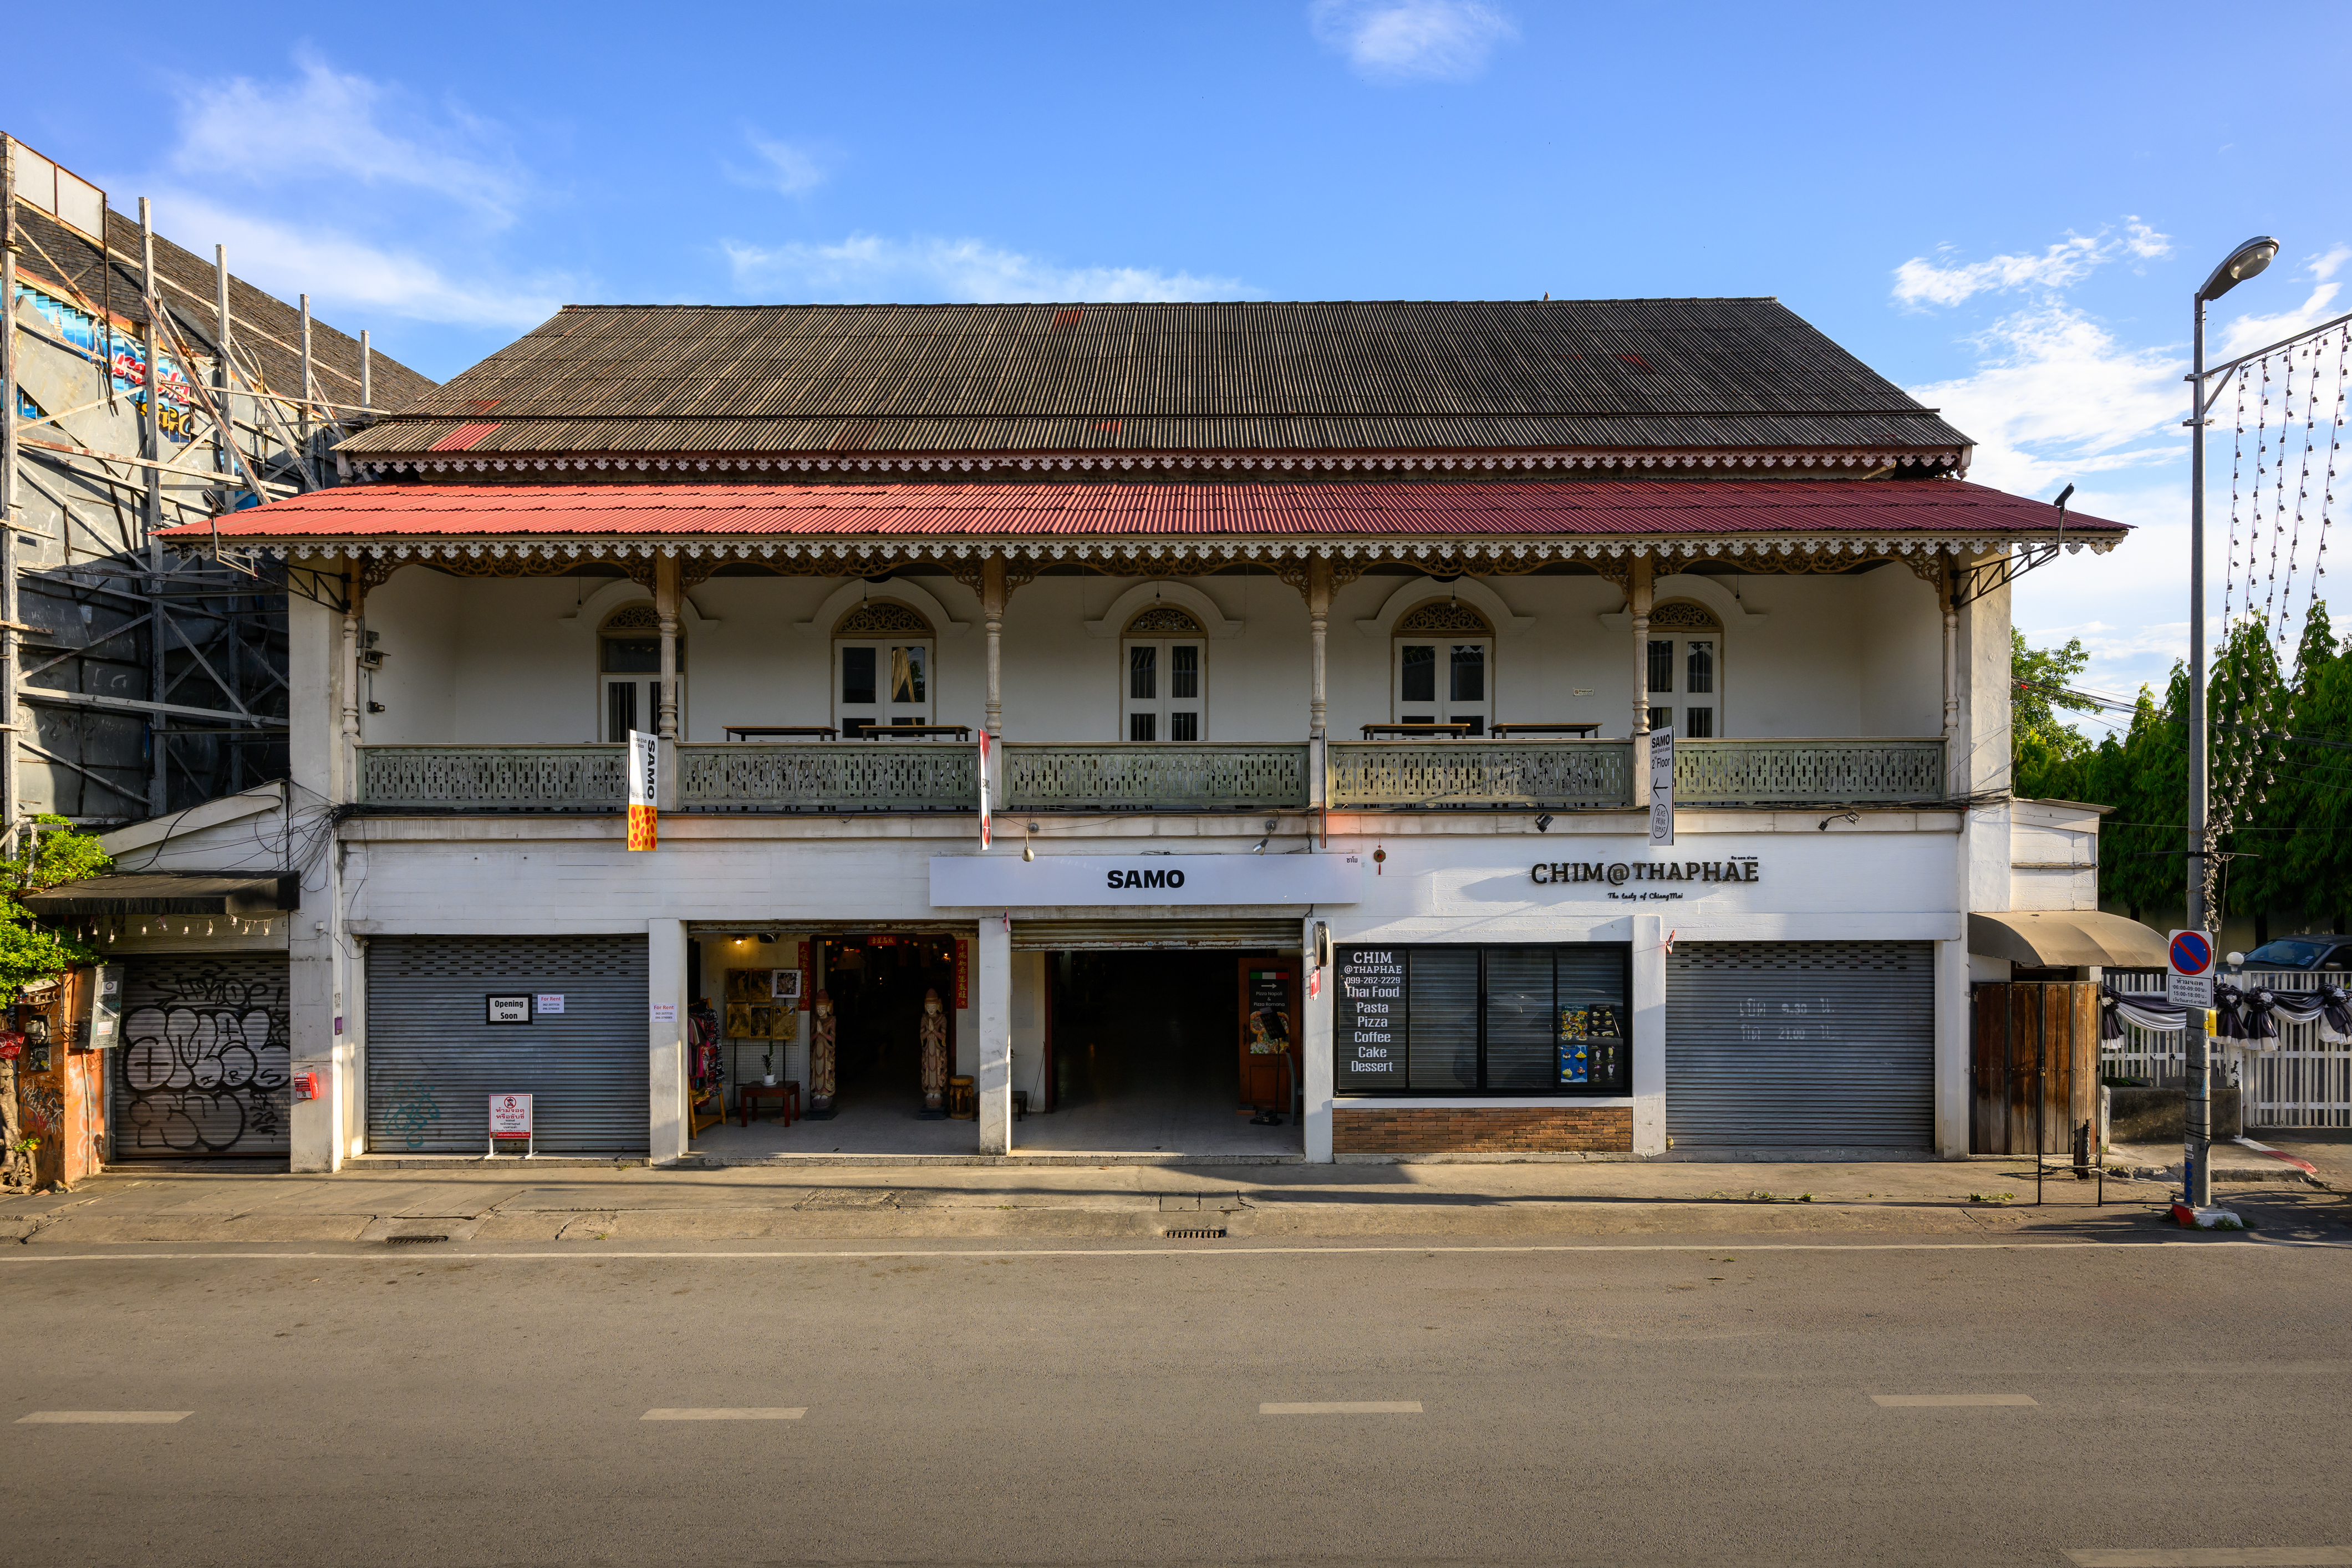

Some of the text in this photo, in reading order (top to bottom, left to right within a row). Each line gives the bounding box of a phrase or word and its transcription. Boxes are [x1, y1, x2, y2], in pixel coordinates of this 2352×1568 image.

[1651, 734, 1670, 749] SAMO
[1657, 757, 1671, 768] Floor
[647, 739, 655, 800] SAMO
[1657, 808, 1666, 817] SLICE
[1656, 817, 1666, 826] DRINK
[1654, 824, 1666, 834] REPEAT
[1107, 869, 1185, 889] SAMO
[1530, 862, 1759, 886] CHIM@THAPHAE
[1621, 892, 1637, 902] tasty
[1640, 892, 1647, 901] of
[1353, 951, 1392, 964] CHIM
[1344, 965, 1402, 974] @THAPHAE
[2176, 978, 2203, 986] ห้ามจอด
[1345, 986, 1399, 997] Thai Food
[495, 1000, 523, 1008] Opening
[1357, 1002, 1388, 1013] Pasta
[1781, 1003, 1808, 1015] 9.30
[1357, 1016, 1388, 1027] Pizza
[1354, 1031, 1391, 1042] Coffee
[1778, 1027, 1806, 1040] 21.00
[1358, 1046, 1387, 1058] Cake
[1351, 1061, 1393, 1072] Dessert
